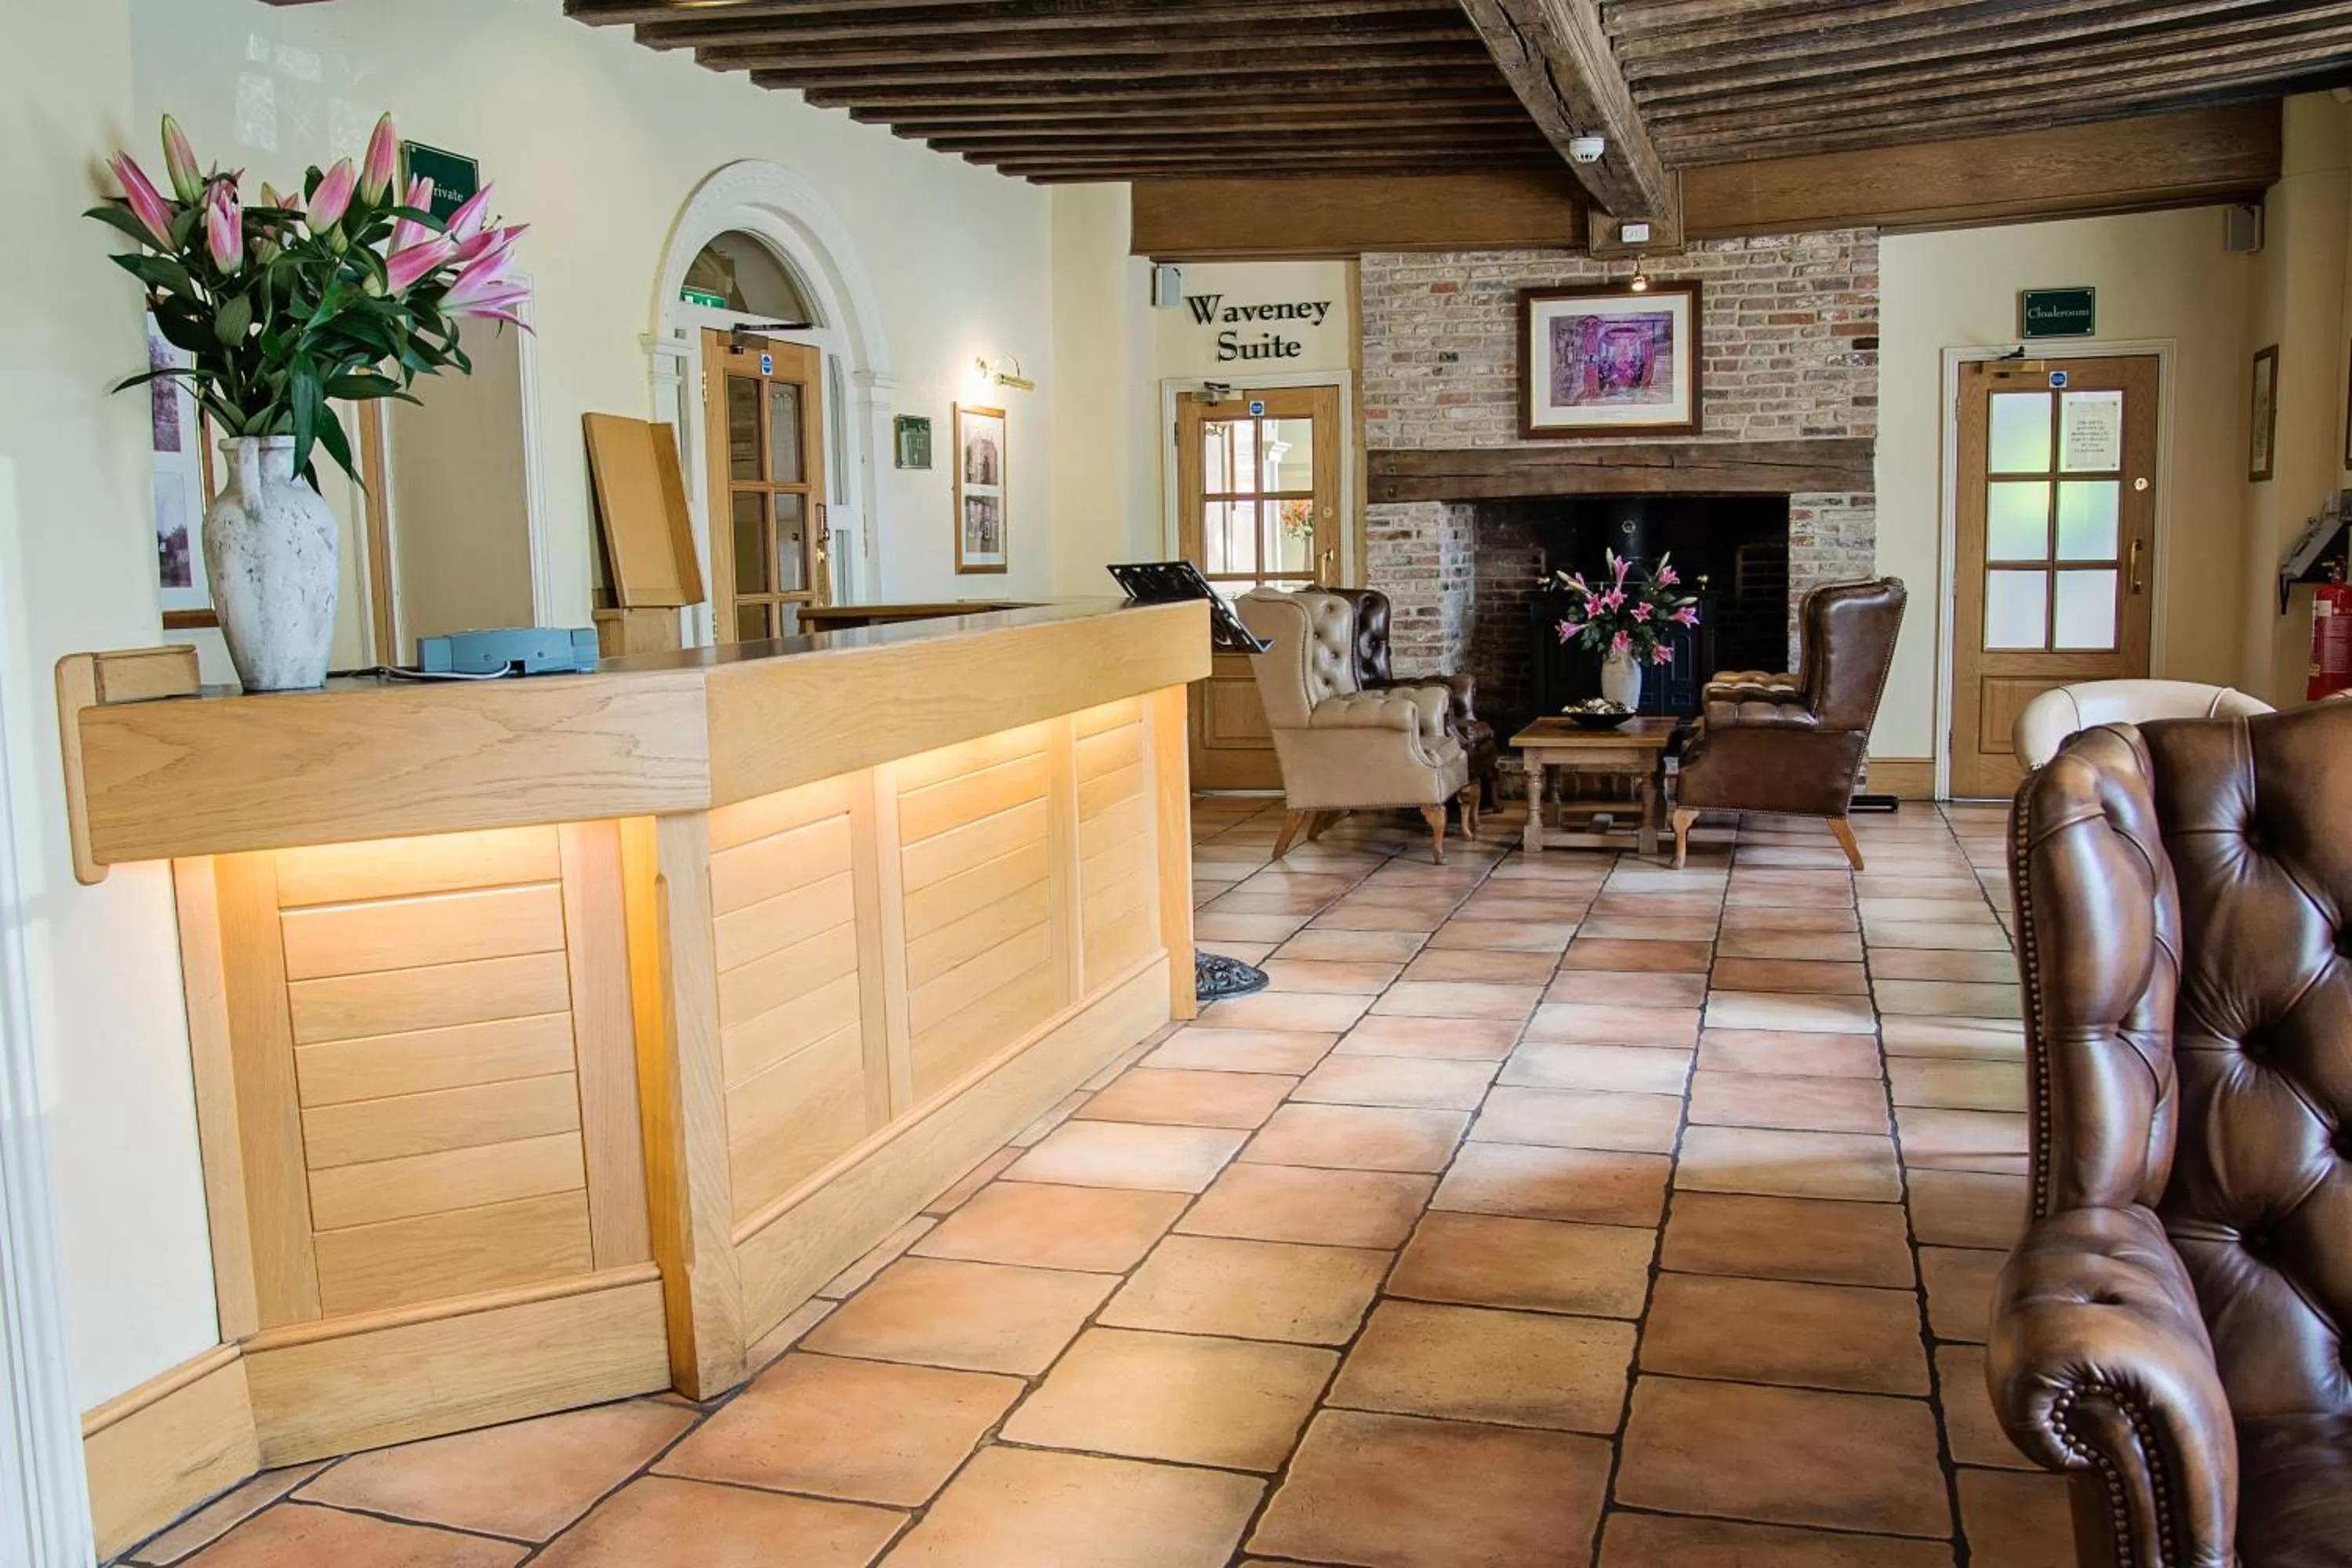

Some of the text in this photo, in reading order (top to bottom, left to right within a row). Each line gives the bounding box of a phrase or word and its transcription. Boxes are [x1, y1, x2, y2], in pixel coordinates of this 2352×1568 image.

[433, 183, 464, 202] rivate
[1185, 293, 1331, 326] Waveney
[1217, 330, 1301, 362] Suite
